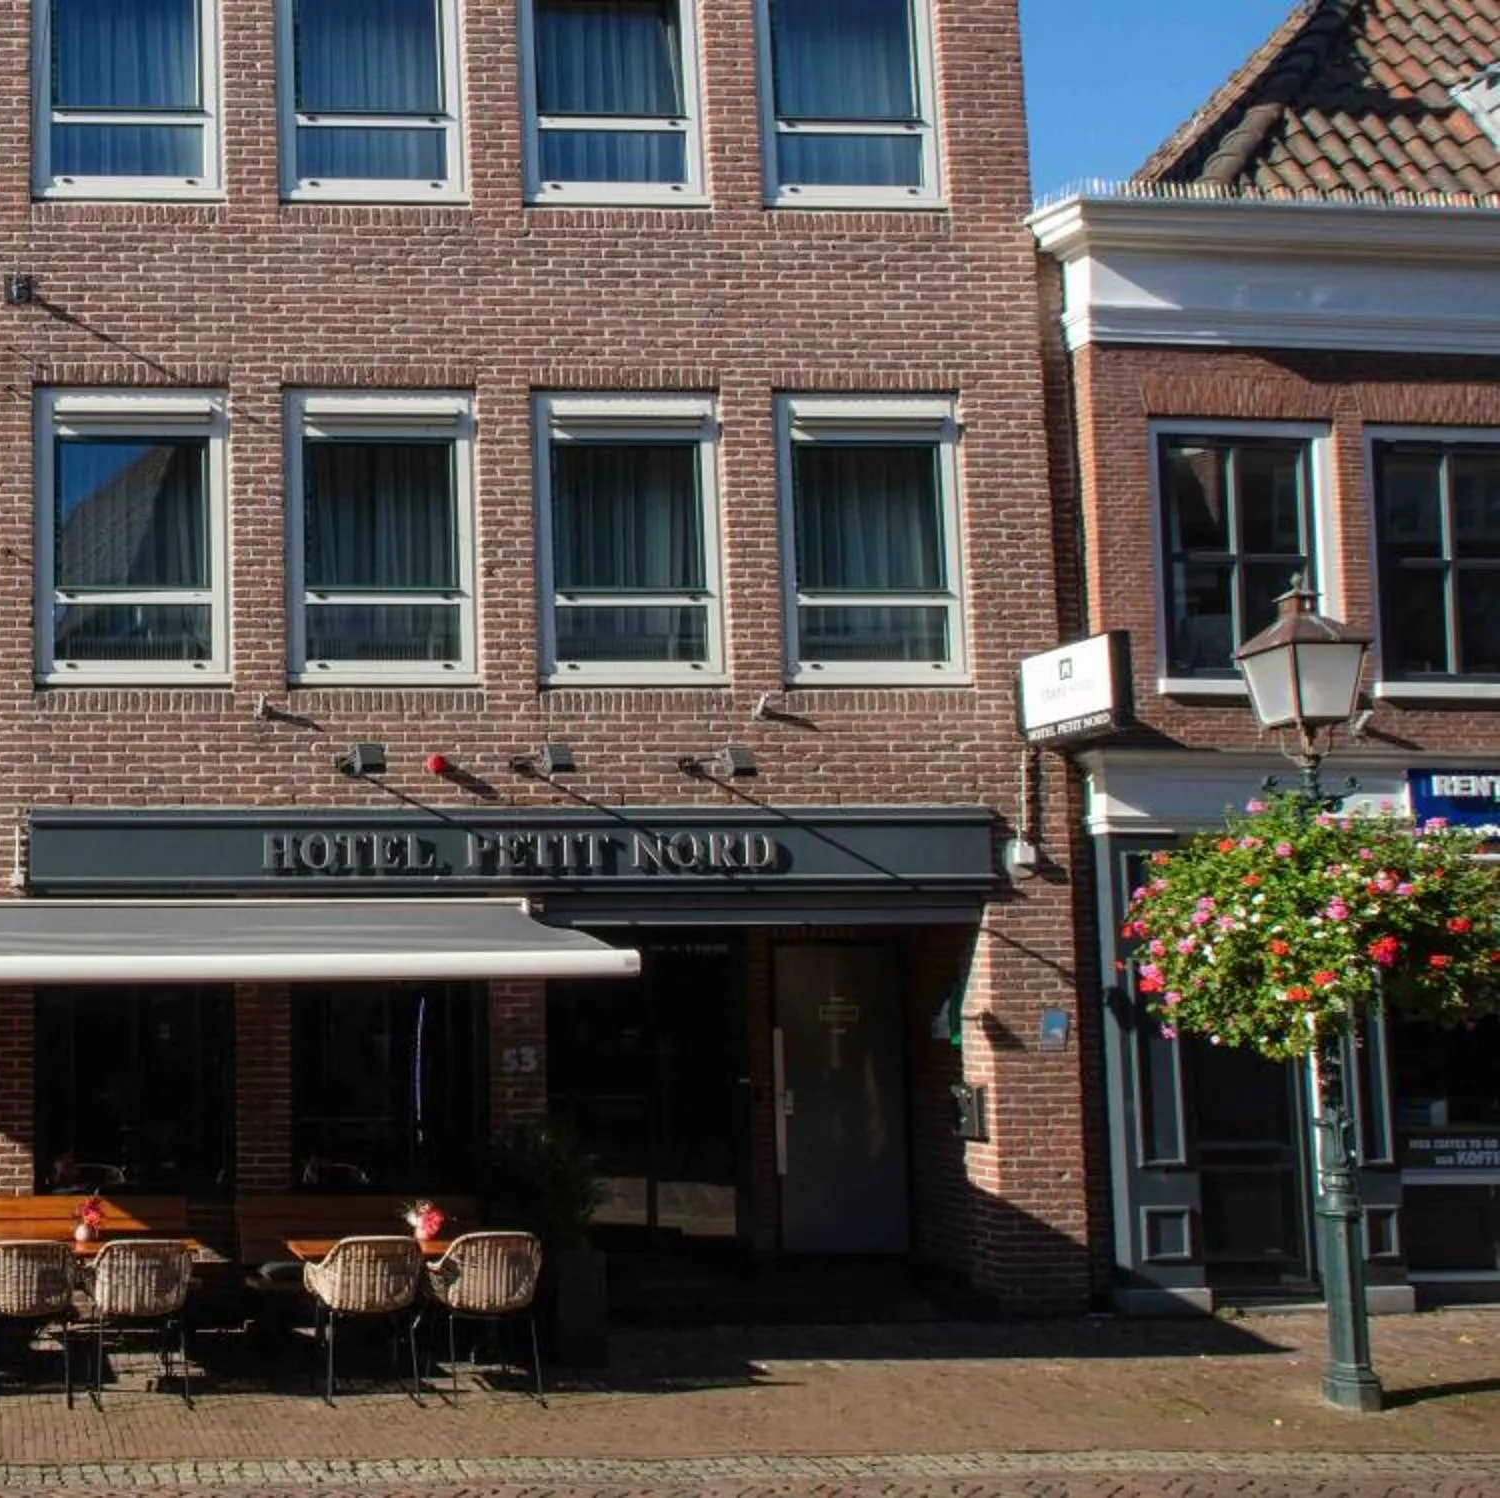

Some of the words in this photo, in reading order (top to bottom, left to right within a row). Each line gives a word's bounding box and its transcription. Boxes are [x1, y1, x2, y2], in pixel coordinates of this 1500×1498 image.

[1057, 719, 1082, 734] PETIT
[260, 831, 436, 869] HOTEL
[466, 830, 610, 868] PETIT
[630, 829, 778, 868] NORD
[501, 1046, 538, 1073] 53
